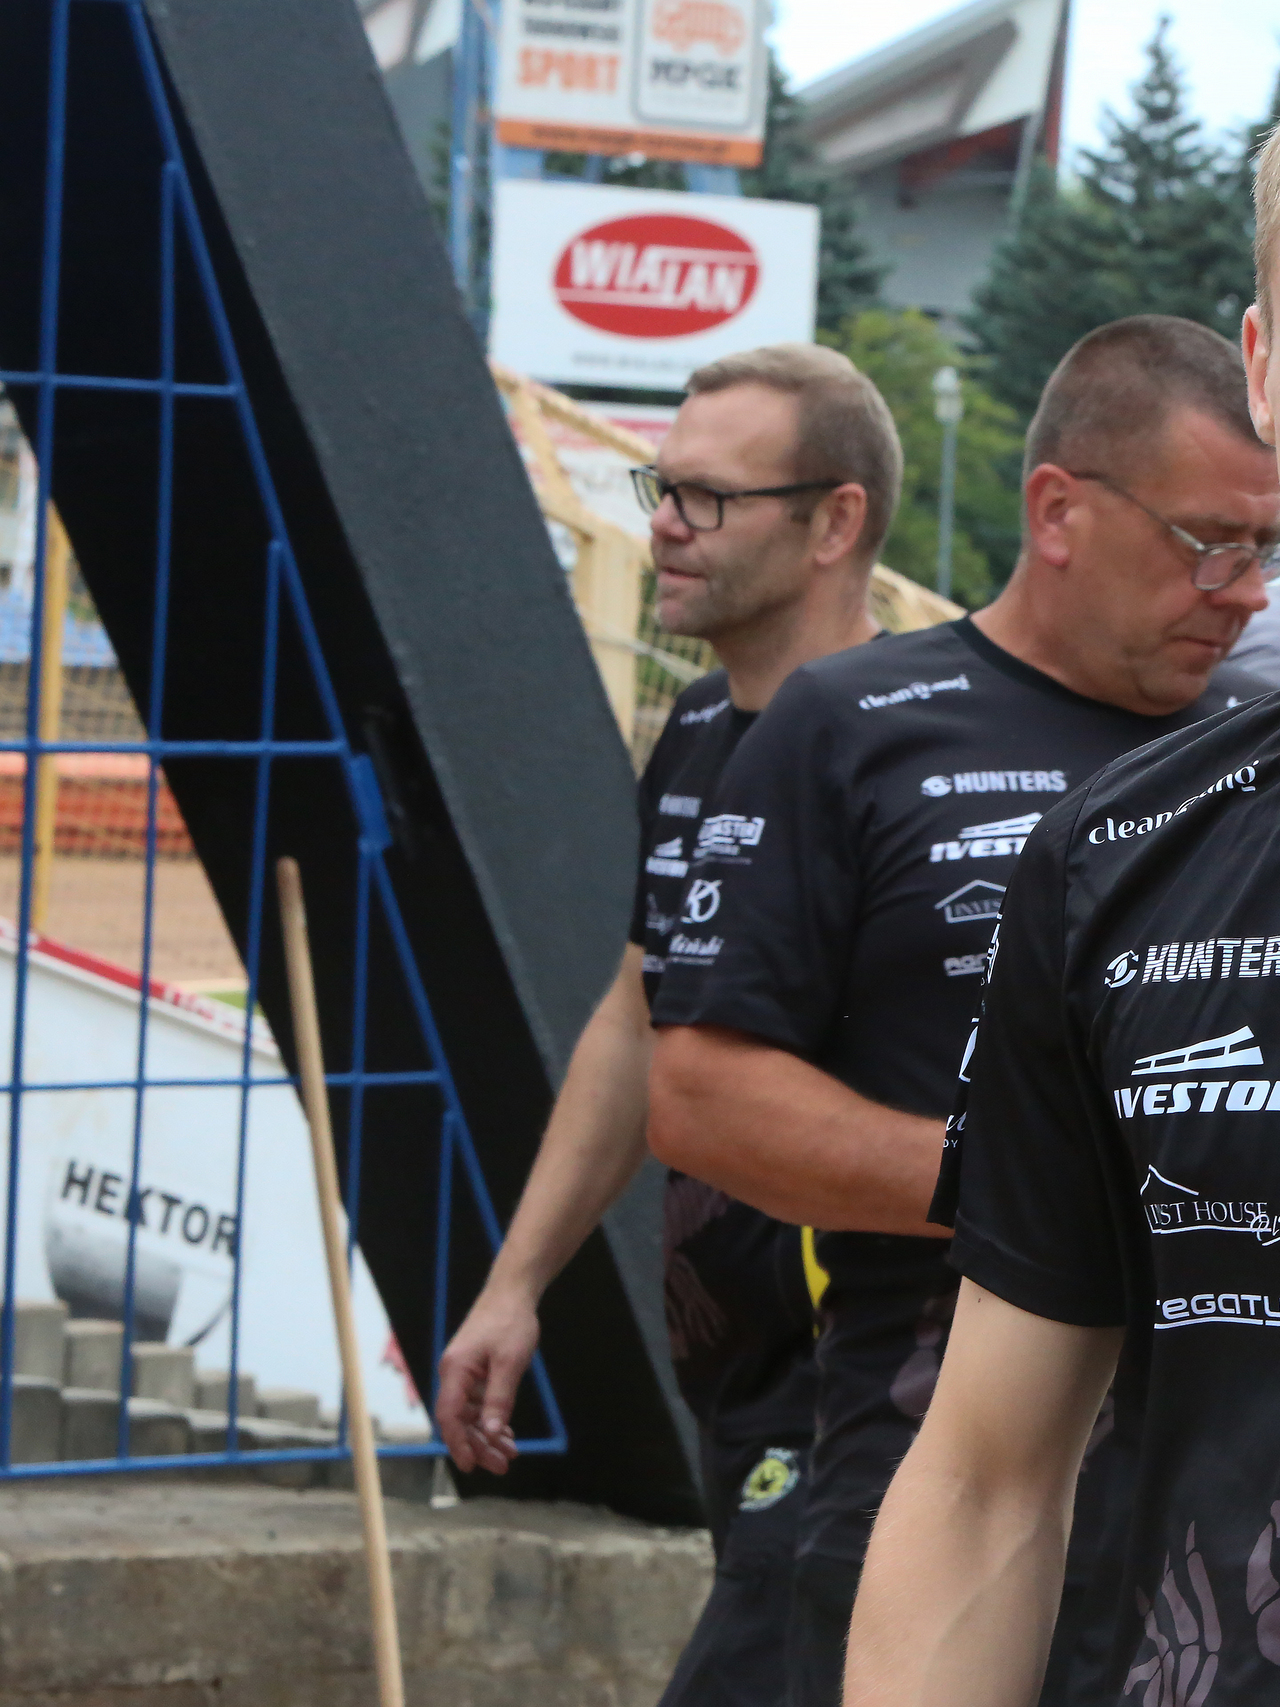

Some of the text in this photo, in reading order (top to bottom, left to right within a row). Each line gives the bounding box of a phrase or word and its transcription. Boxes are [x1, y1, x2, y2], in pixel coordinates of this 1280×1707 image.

[953, 769, 1067, 794] HUNTERS
[61, 1159, 239, 1259] HEKTOR
[1194, 1201, 1268, 1224] HOUSE
